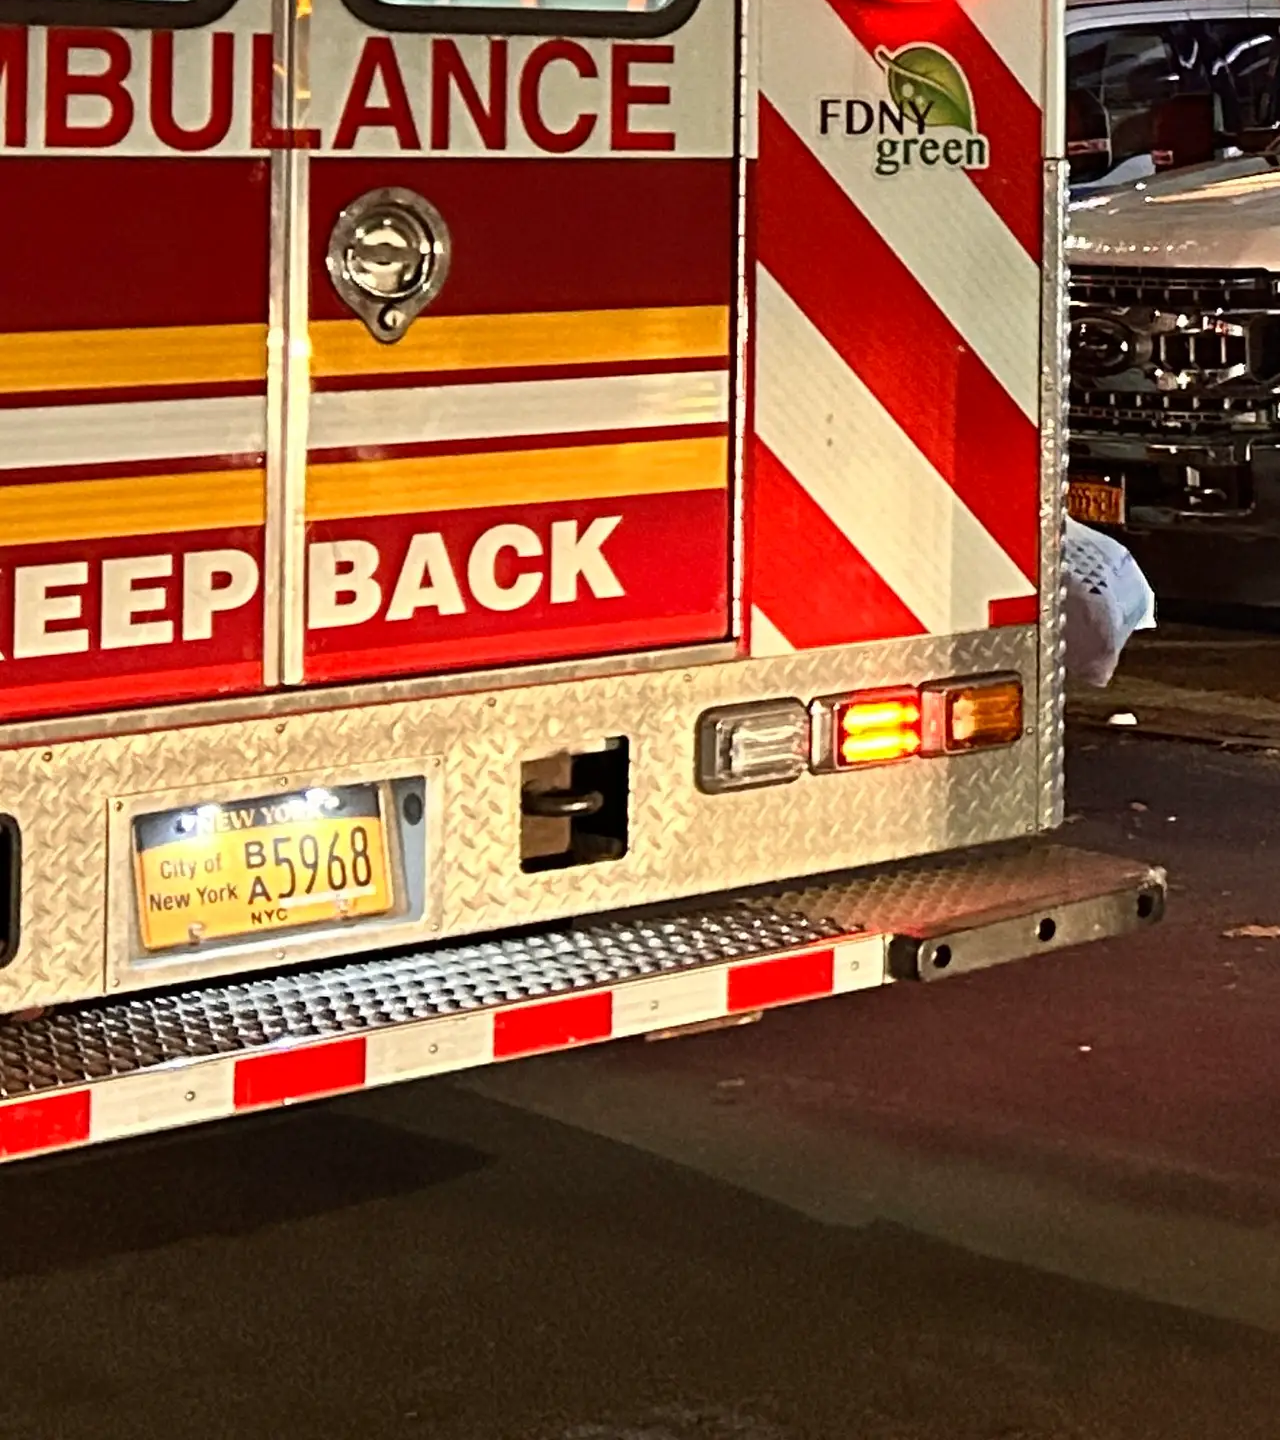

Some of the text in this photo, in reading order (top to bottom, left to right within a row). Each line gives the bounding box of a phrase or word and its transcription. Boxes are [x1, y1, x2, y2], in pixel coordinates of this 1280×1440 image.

[0, 25, 677, 155] BULANCE
[820, 99, 934, 136] FDNY
[875, 137, 986, 175] green
[0, 515, 625, 662] EEP BACK
[160, 852, 222, 880] City of
[273, 826, 372, 899] 5968
[150, 883, 238, 912] New York
[251, 908, 288, 924] NYC
